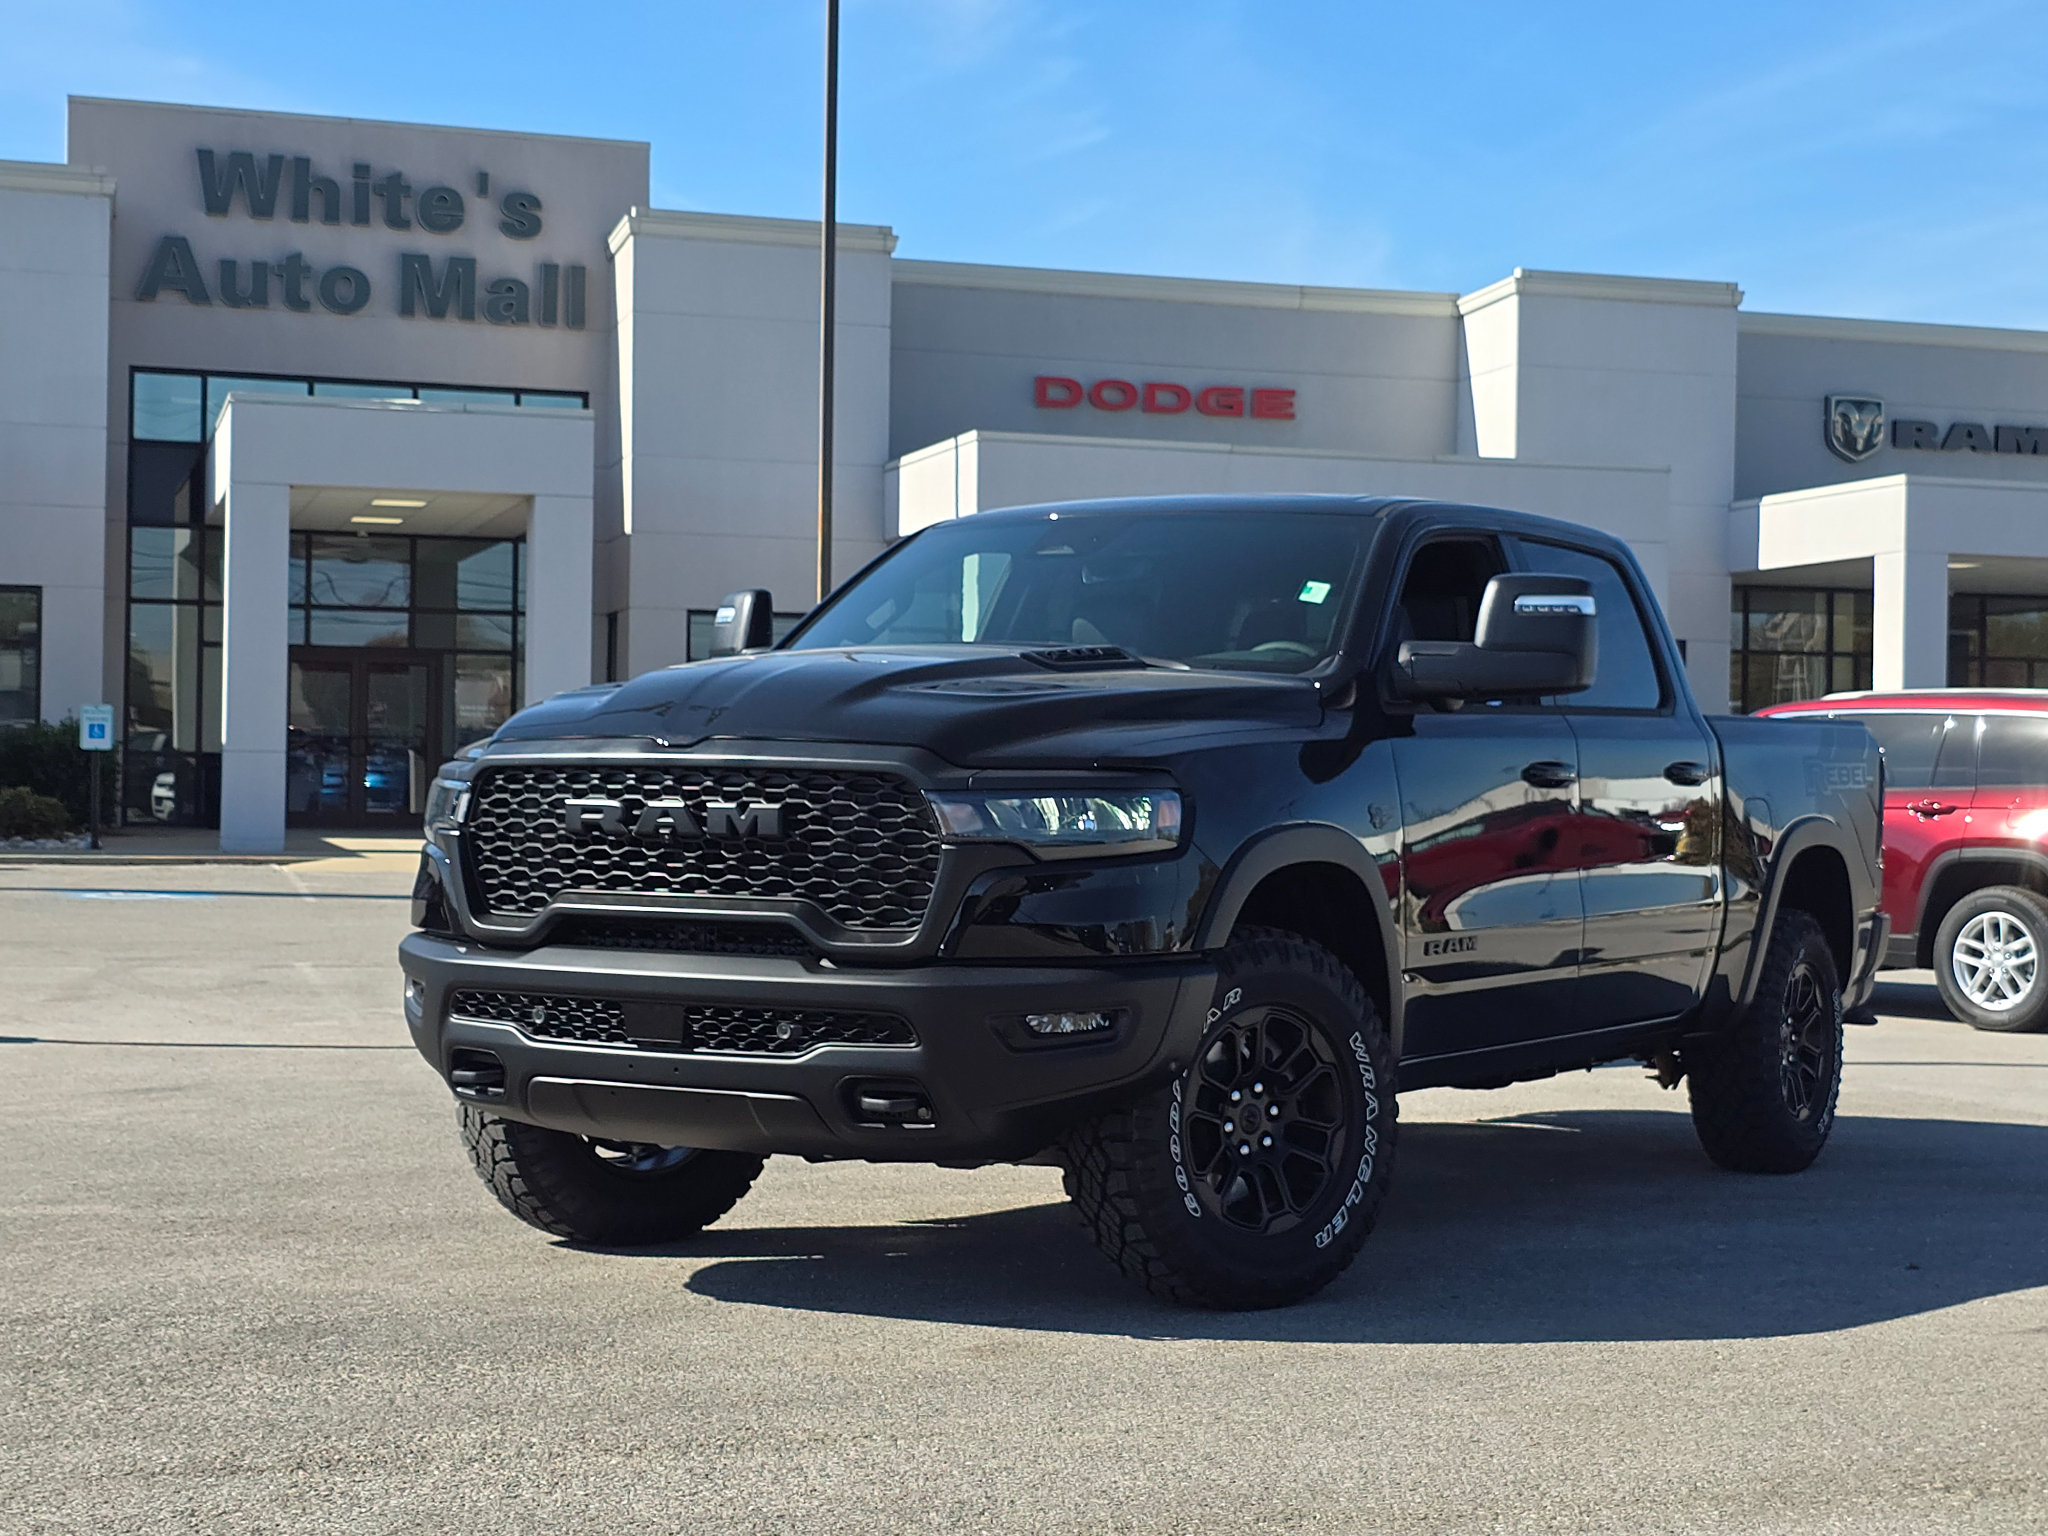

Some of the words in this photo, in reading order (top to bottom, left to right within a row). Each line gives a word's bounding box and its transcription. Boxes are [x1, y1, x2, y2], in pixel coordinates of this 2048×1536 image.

[196, 149, 543, 240] White's
[136, 235, 372, 316] Auto
[399, 252, 587, 329] Mall
[1034, 376, 1296, 419] DODGE
[1891, 419, 2048, 455] RAM
[564, 799, 784, 839] RAM
[1423, 935, 1478, 957] RAM
[1314, 1031, 1379, 1249] WRANGLER
